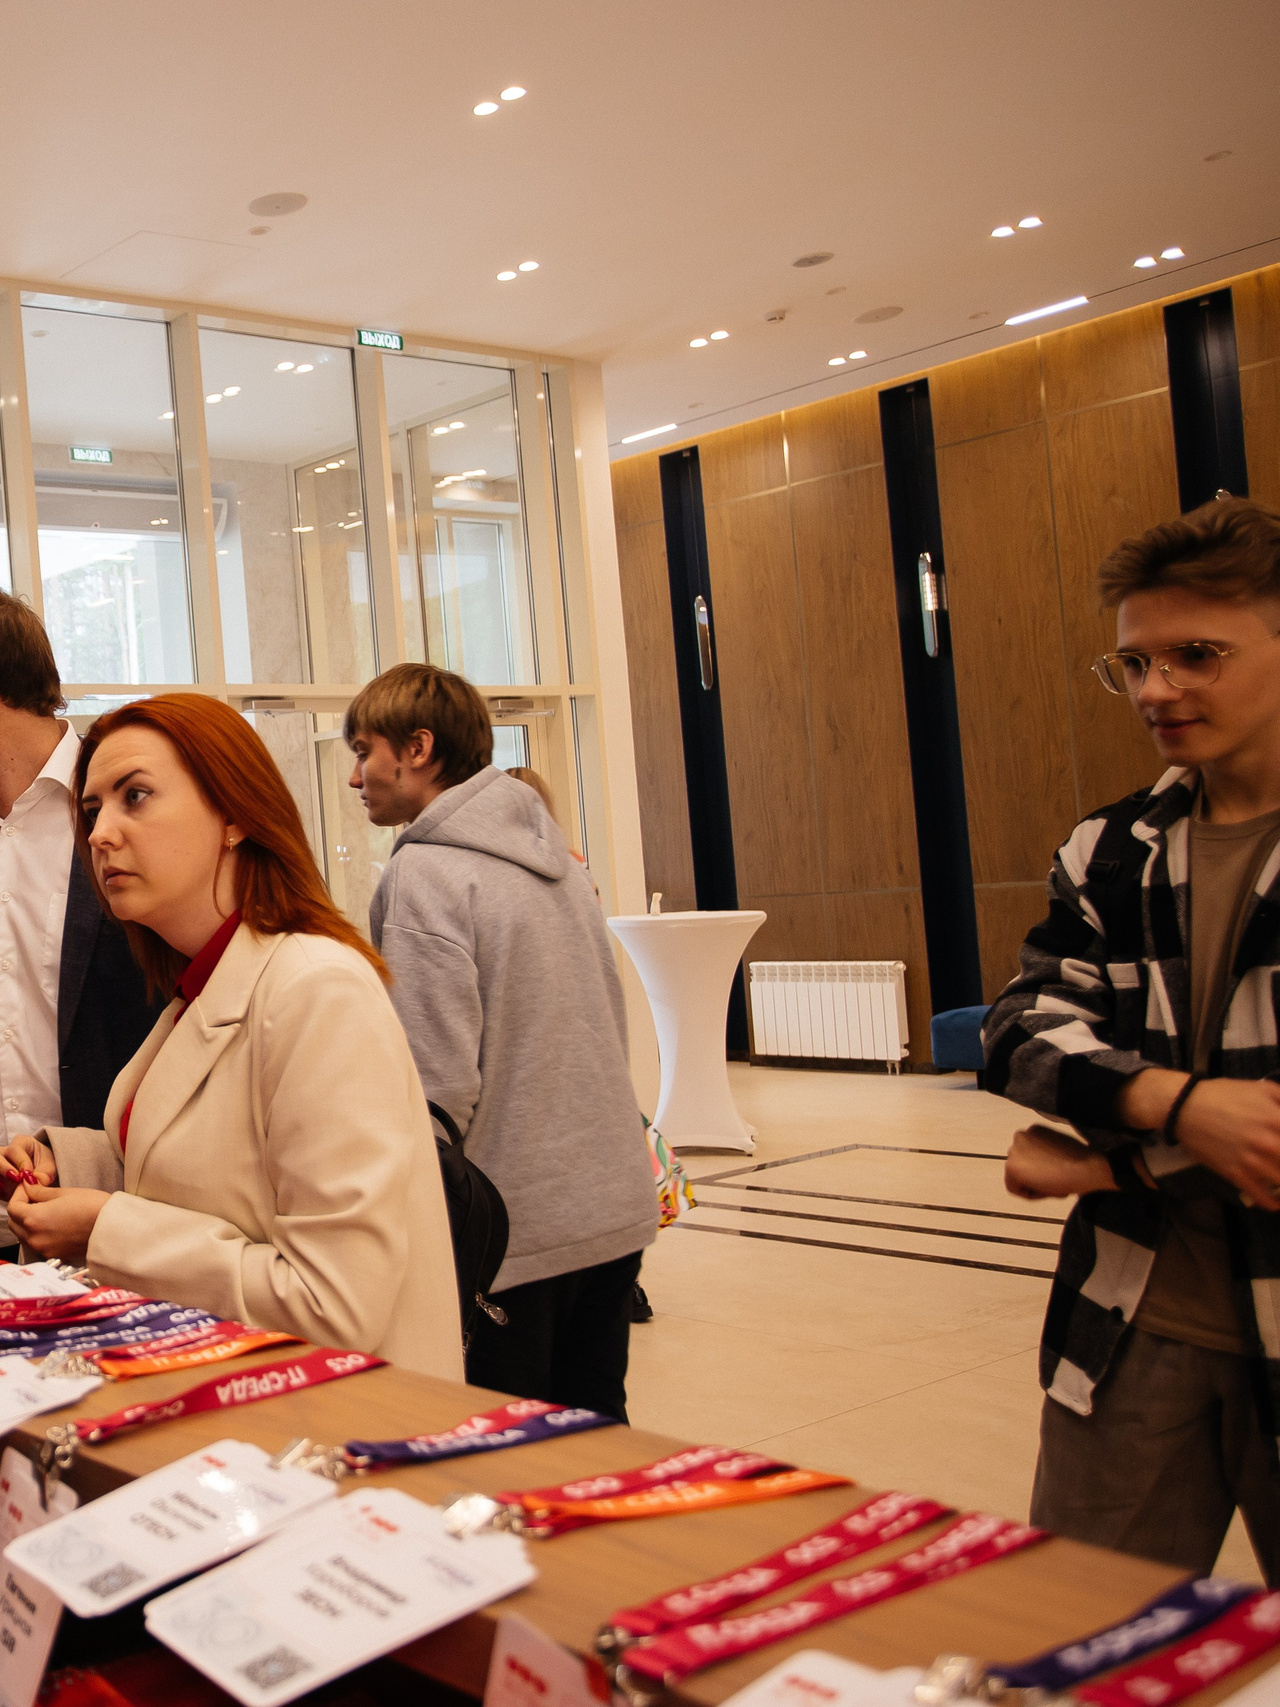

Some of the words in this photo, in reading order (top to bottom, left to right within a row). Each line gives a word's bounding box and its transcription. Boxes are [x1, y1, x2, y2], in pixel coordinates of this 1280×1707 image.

[361, 331, 401, 349] ВЫХОД
[73, 448, 111, 462] ВЫХОД
[325, 1353, 366, 1372] OCS
[216, 1365, 308, 1404] IT-СРЕДА
